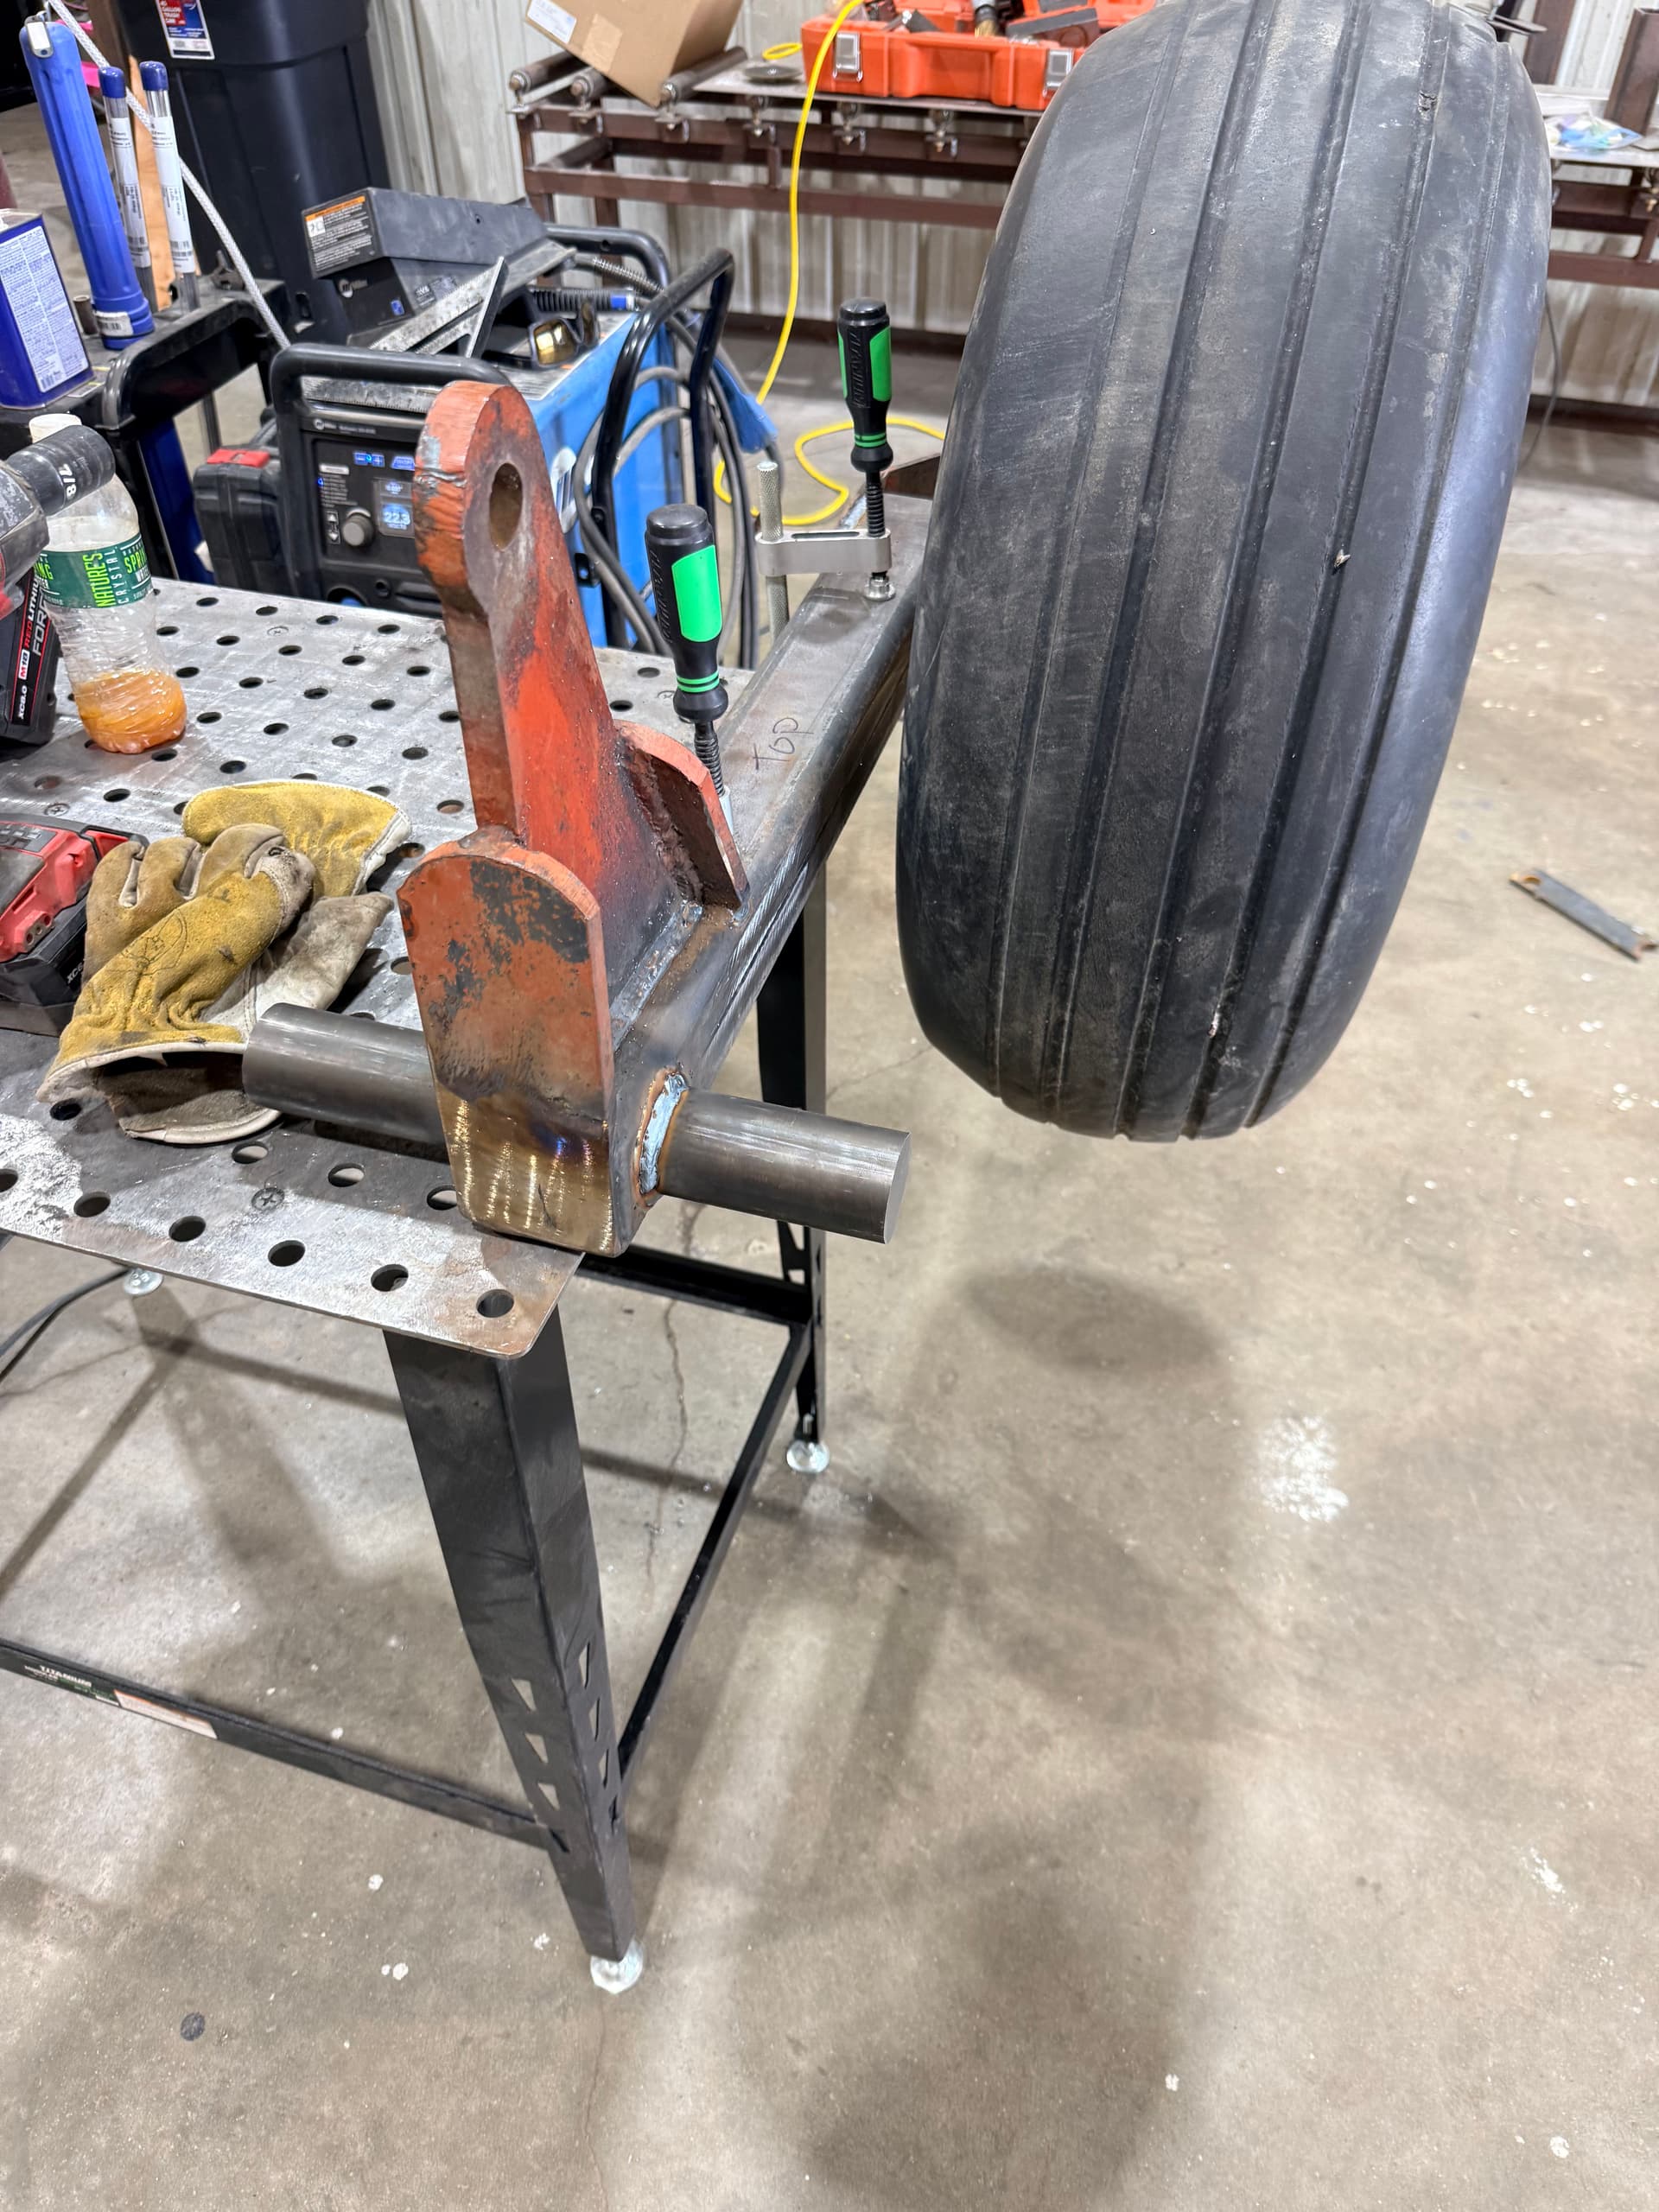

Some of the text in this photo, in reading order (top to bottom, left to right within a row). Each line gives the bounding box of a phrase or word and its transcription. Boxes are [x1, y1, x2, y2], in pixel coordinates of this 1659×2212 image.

[82, 552, 117, 607] NATURE'S
[103, 548, 130, 605] CRYSTAL
[23, 575, 40, 649] REDLITHIU
[32, 586, 48, 656] FOR
[19, 652, 30, 679] M18
